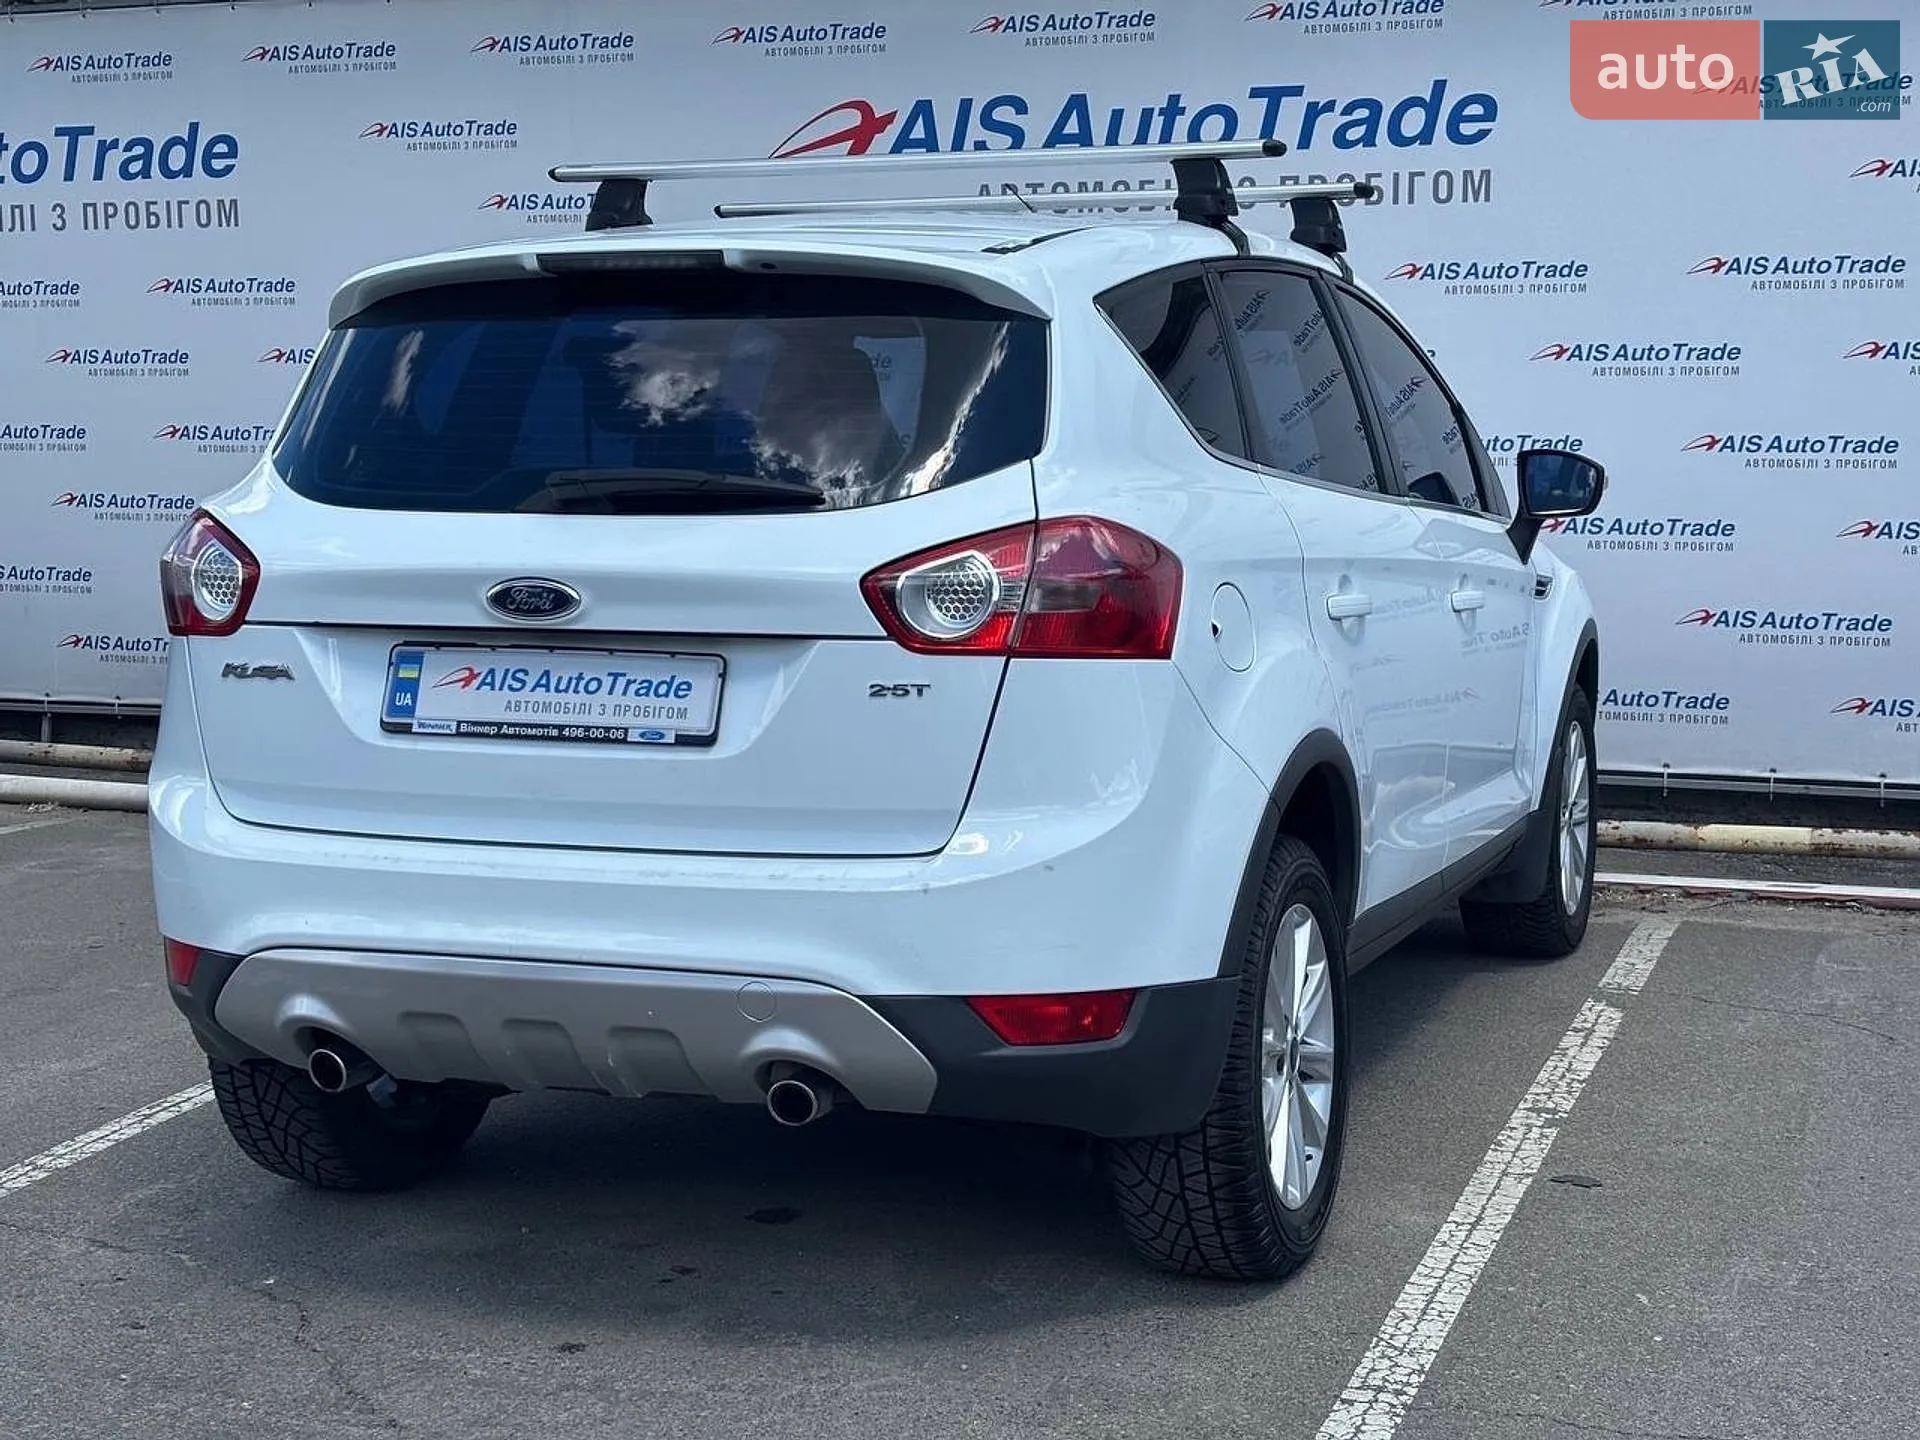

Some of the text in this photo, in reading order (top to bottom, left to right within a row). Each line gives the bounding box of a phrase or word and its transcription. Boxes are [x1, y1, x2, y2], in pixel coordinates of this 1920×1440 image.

[1279, 2, 1319, 20] AIS
[1001, 10, 1156, 33] AIS AutoTrade
[743, 22, 886, 43] AIS AutoTrade
[268, 41, 396, 62] AIS AutoTrade
[498, 32, 634, 53] AIS AutoTrade
[52, 51, 173, 72] AIS AutoTrade
[888, 79, 1499, 154] AIS AutoTrade
[387, 119, 517, 138] AIS AutoTrade
[1888, 159, 1920, 177] AI
[505, 193, 539, 211] AIS
[51, 203, 67, 231] З
[82, 199, 240, 230] ПРОБІГОМ
[1419, 260, 1588, 280] AIS AutoTrade
[1724, 254, 1906, 275] AIS AutoTrade
[172, 276, 296, 294] AIS AutoTrade
[70, 349, 189, 364] AIS AutoTrade
[1566, 343, 1741, 361] AIS AutoTrade
[1592, 366, 1740, 376] АВТОМОБІЛІ З ПРОБІГОМ
[1, 424, 87, 440] AutoTrade
[178, 425, 209, 440] AIS
[1718, 435, 1899, 454] AIS AutoTrade
[1745, 458, 1897, 469] АВТОМОБІЛІ З ПРОБІГОМ
[75, 493, 195, 510] AIS AutoTrade
[1562, 518, 1735, 537] AIS AutoTrade
[1875, 521, 1920, 540] AIS
[7, 565, 92, 582] AutoTrade
[506, 586, 555, 609] Ford
[1713, 610, 1892, 632] AIS AutoTrade
[81, 635, 111, 651] AIS
[476, 667, 693, 699] AIS AutoTrade
[395, 692, 412, 706] UA
[1602, 689, 1730, 710] AutoTrade
[1868, 698, 1915, 717] AIS
[504, 700, 688, 720] АВТОМОБІЛІ З ПРОБІГОМ
